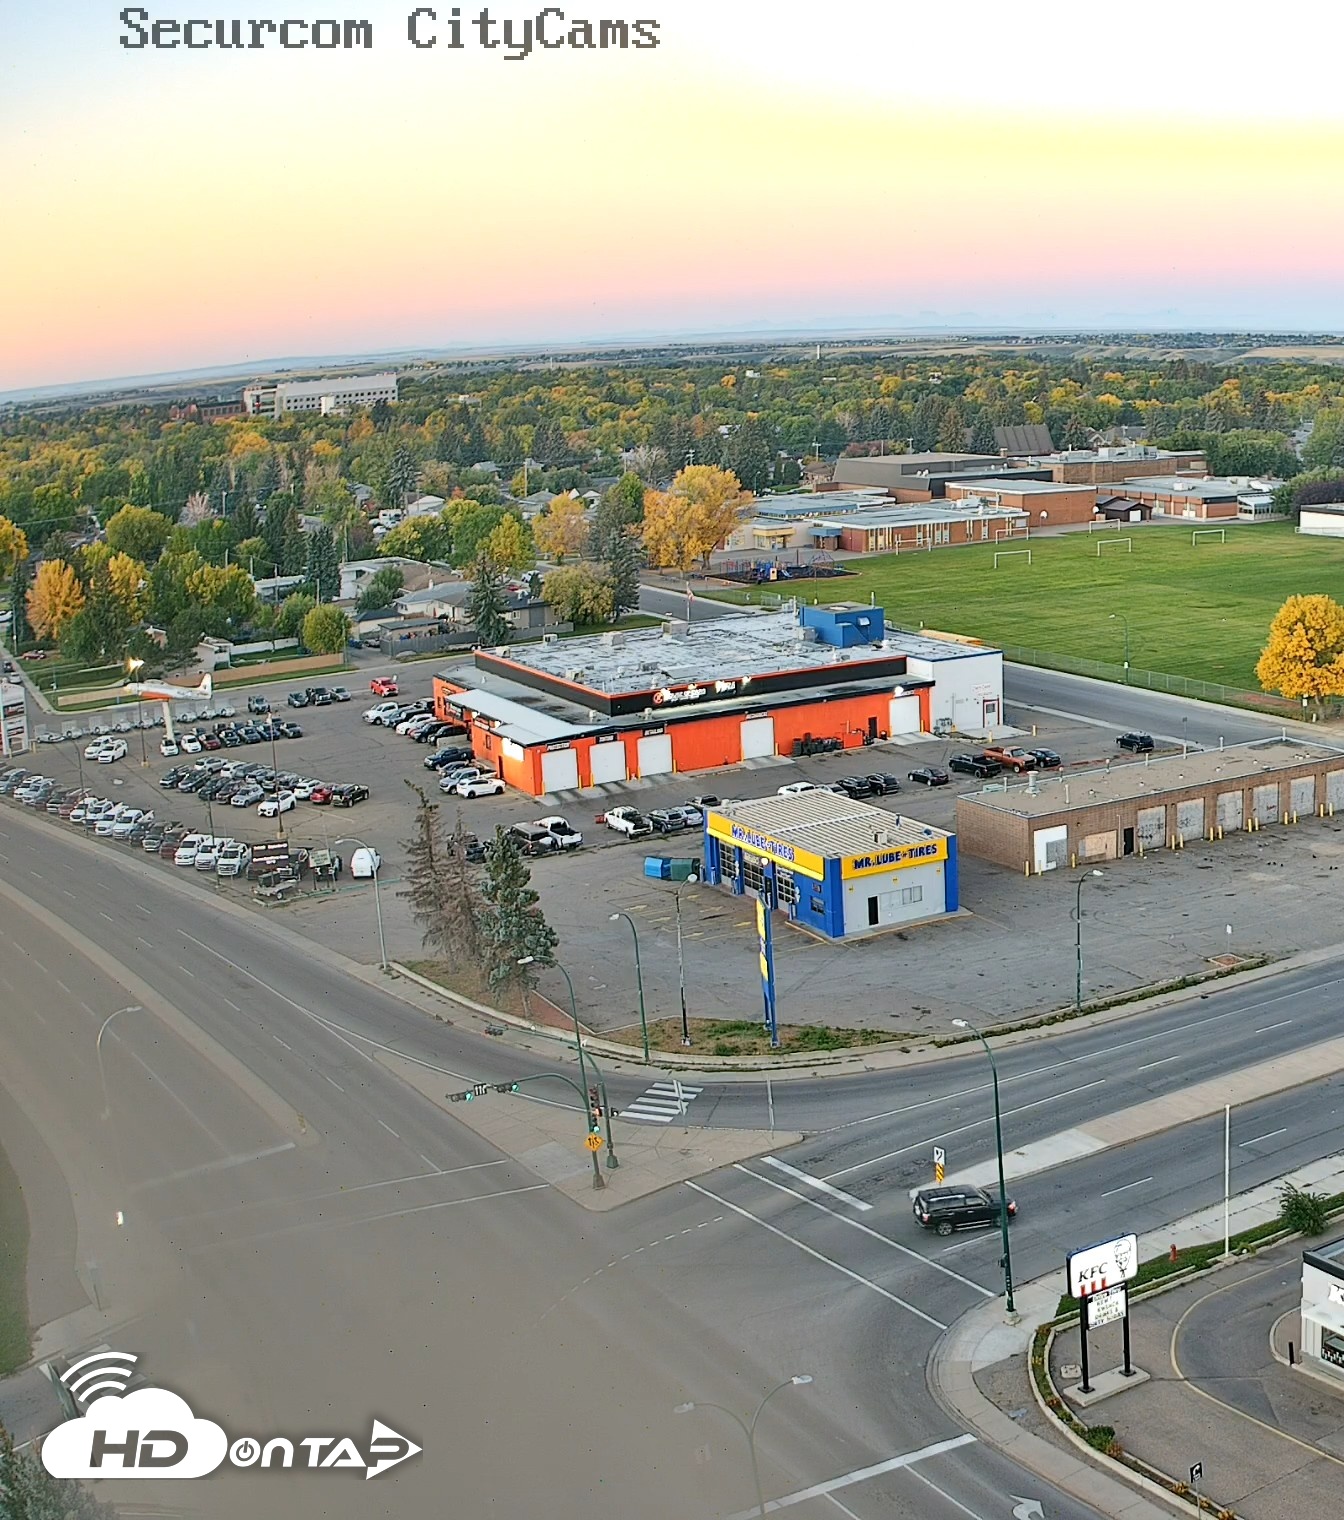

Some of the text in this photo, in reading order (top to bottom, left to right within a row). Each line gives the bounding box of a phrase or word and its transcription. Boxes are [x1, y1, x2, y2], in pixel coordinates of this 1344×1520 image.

[747, 831, 767, 851] LUBE
[770, 841, 795, 862] TIRES
[853, 858, 875, 869] MR.
[876, 851, 901, 865] LUBE
[908, 844, 937, 858] TIRES
[1078, 1262, 1109, 1283] KFC
